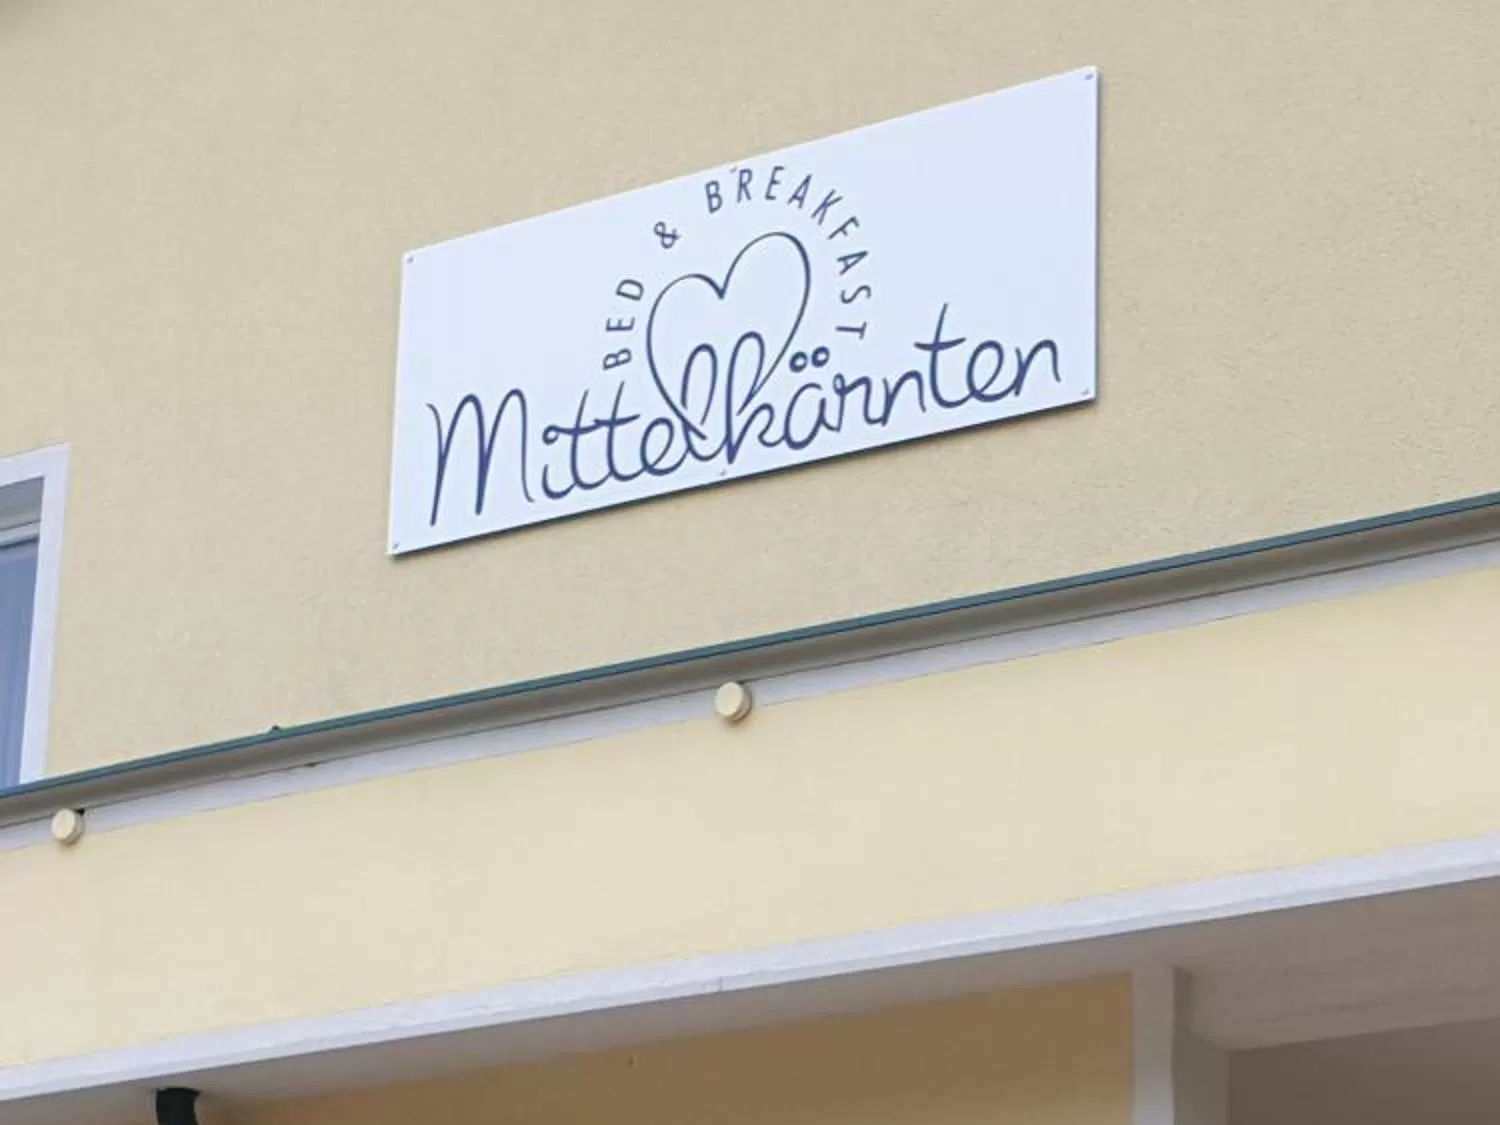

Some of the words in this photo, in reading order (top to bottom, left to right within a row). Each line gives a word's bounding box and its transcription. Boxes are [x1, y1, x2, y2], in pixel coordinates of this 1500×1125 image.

[602, 277, 645, 370] BED
[653, 219, 682, 249] &
[704, 165, 873, 340] BREAKFAST
[425, 303, 1062, 527] Mittelkärnten
